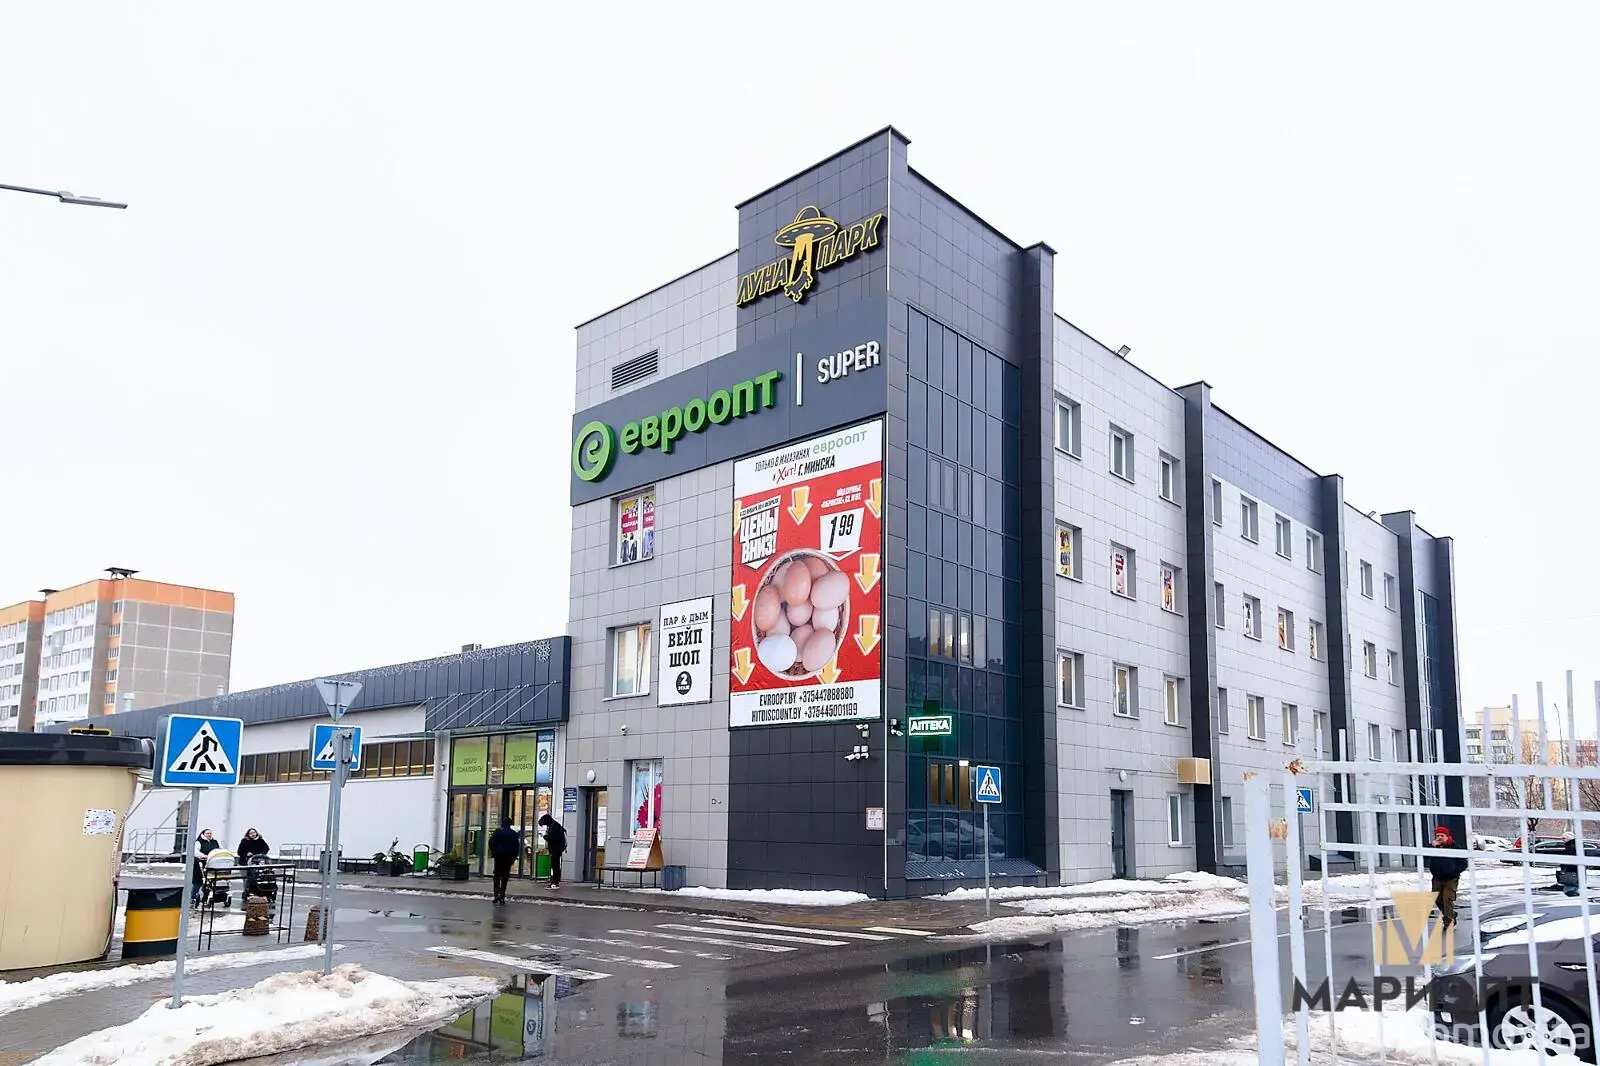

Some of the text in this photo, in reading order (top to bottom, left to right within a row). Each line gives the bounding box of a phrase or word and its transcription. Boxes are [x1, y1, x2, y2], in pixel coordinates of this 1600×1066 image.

[736, 213, 884, 307] ЛУНА ПАРК
[817, 340, 881, 384] SUPER
[619, 369, 784, 455] евроопт
[812, 430, 867, 455] евроопт
[740, 506, 779, 543] ЦЕНЫ
[663, 611, 709, 627] ПАР & ДЫМ
[668, 627, 703, 648] ВЕЙП
[669, 650, 701, 668] ШОП
[680, 672, 688, 685] 2
[759, 691, 797, 706] EVROOPT.BY
[751, 706, 802, 723] HITDISCOUNT.BY
[910, 719, 950, 731] АПТЕКА
[541, 751, 546, 761] 2
